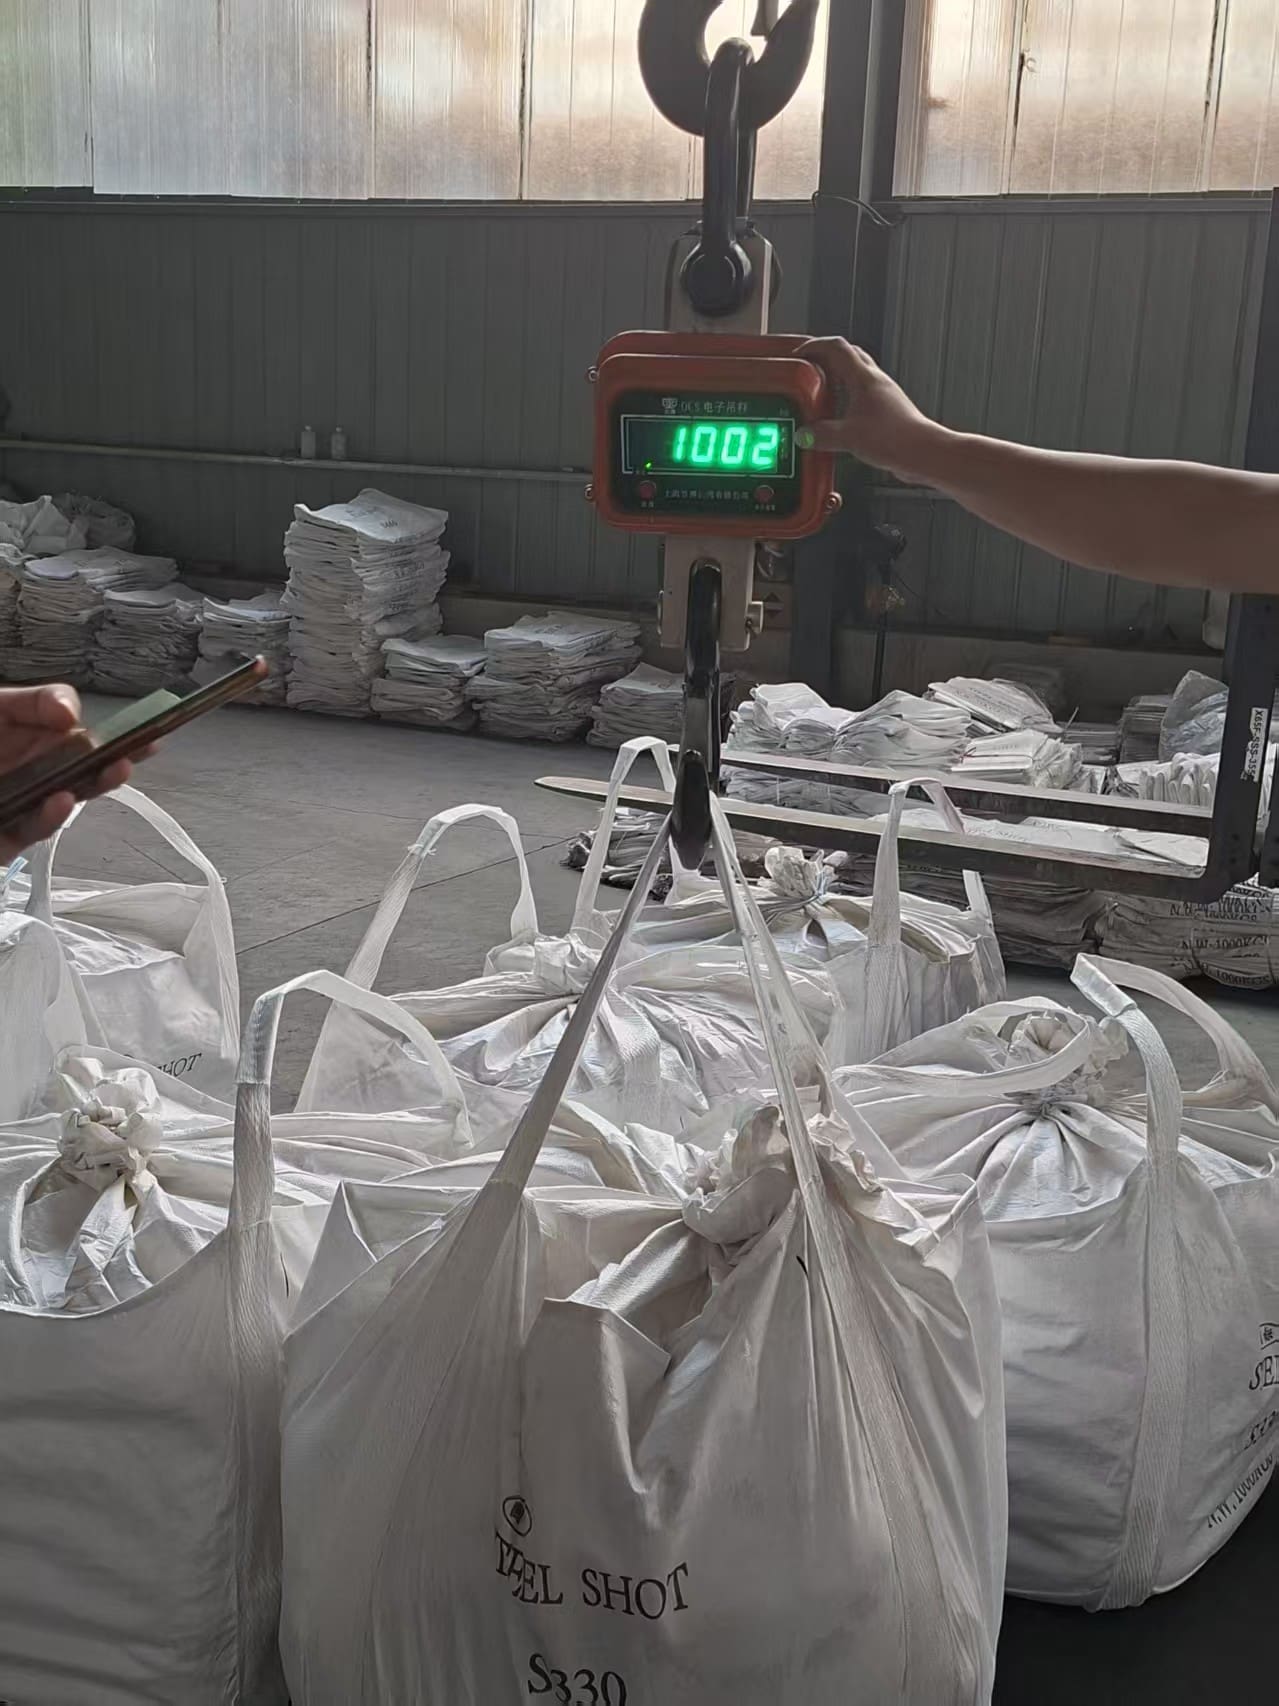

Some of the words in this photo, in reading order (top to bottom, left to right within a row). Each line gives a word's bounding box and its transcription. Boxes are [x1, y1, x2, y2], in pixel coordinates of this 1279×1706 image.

[673, 424, 780, 467] 1002
[157, 1052, 203, 1077] HOT
[580, 1561, 689, 1620] SHOT
[527, 1651, 628, 1706] S330
